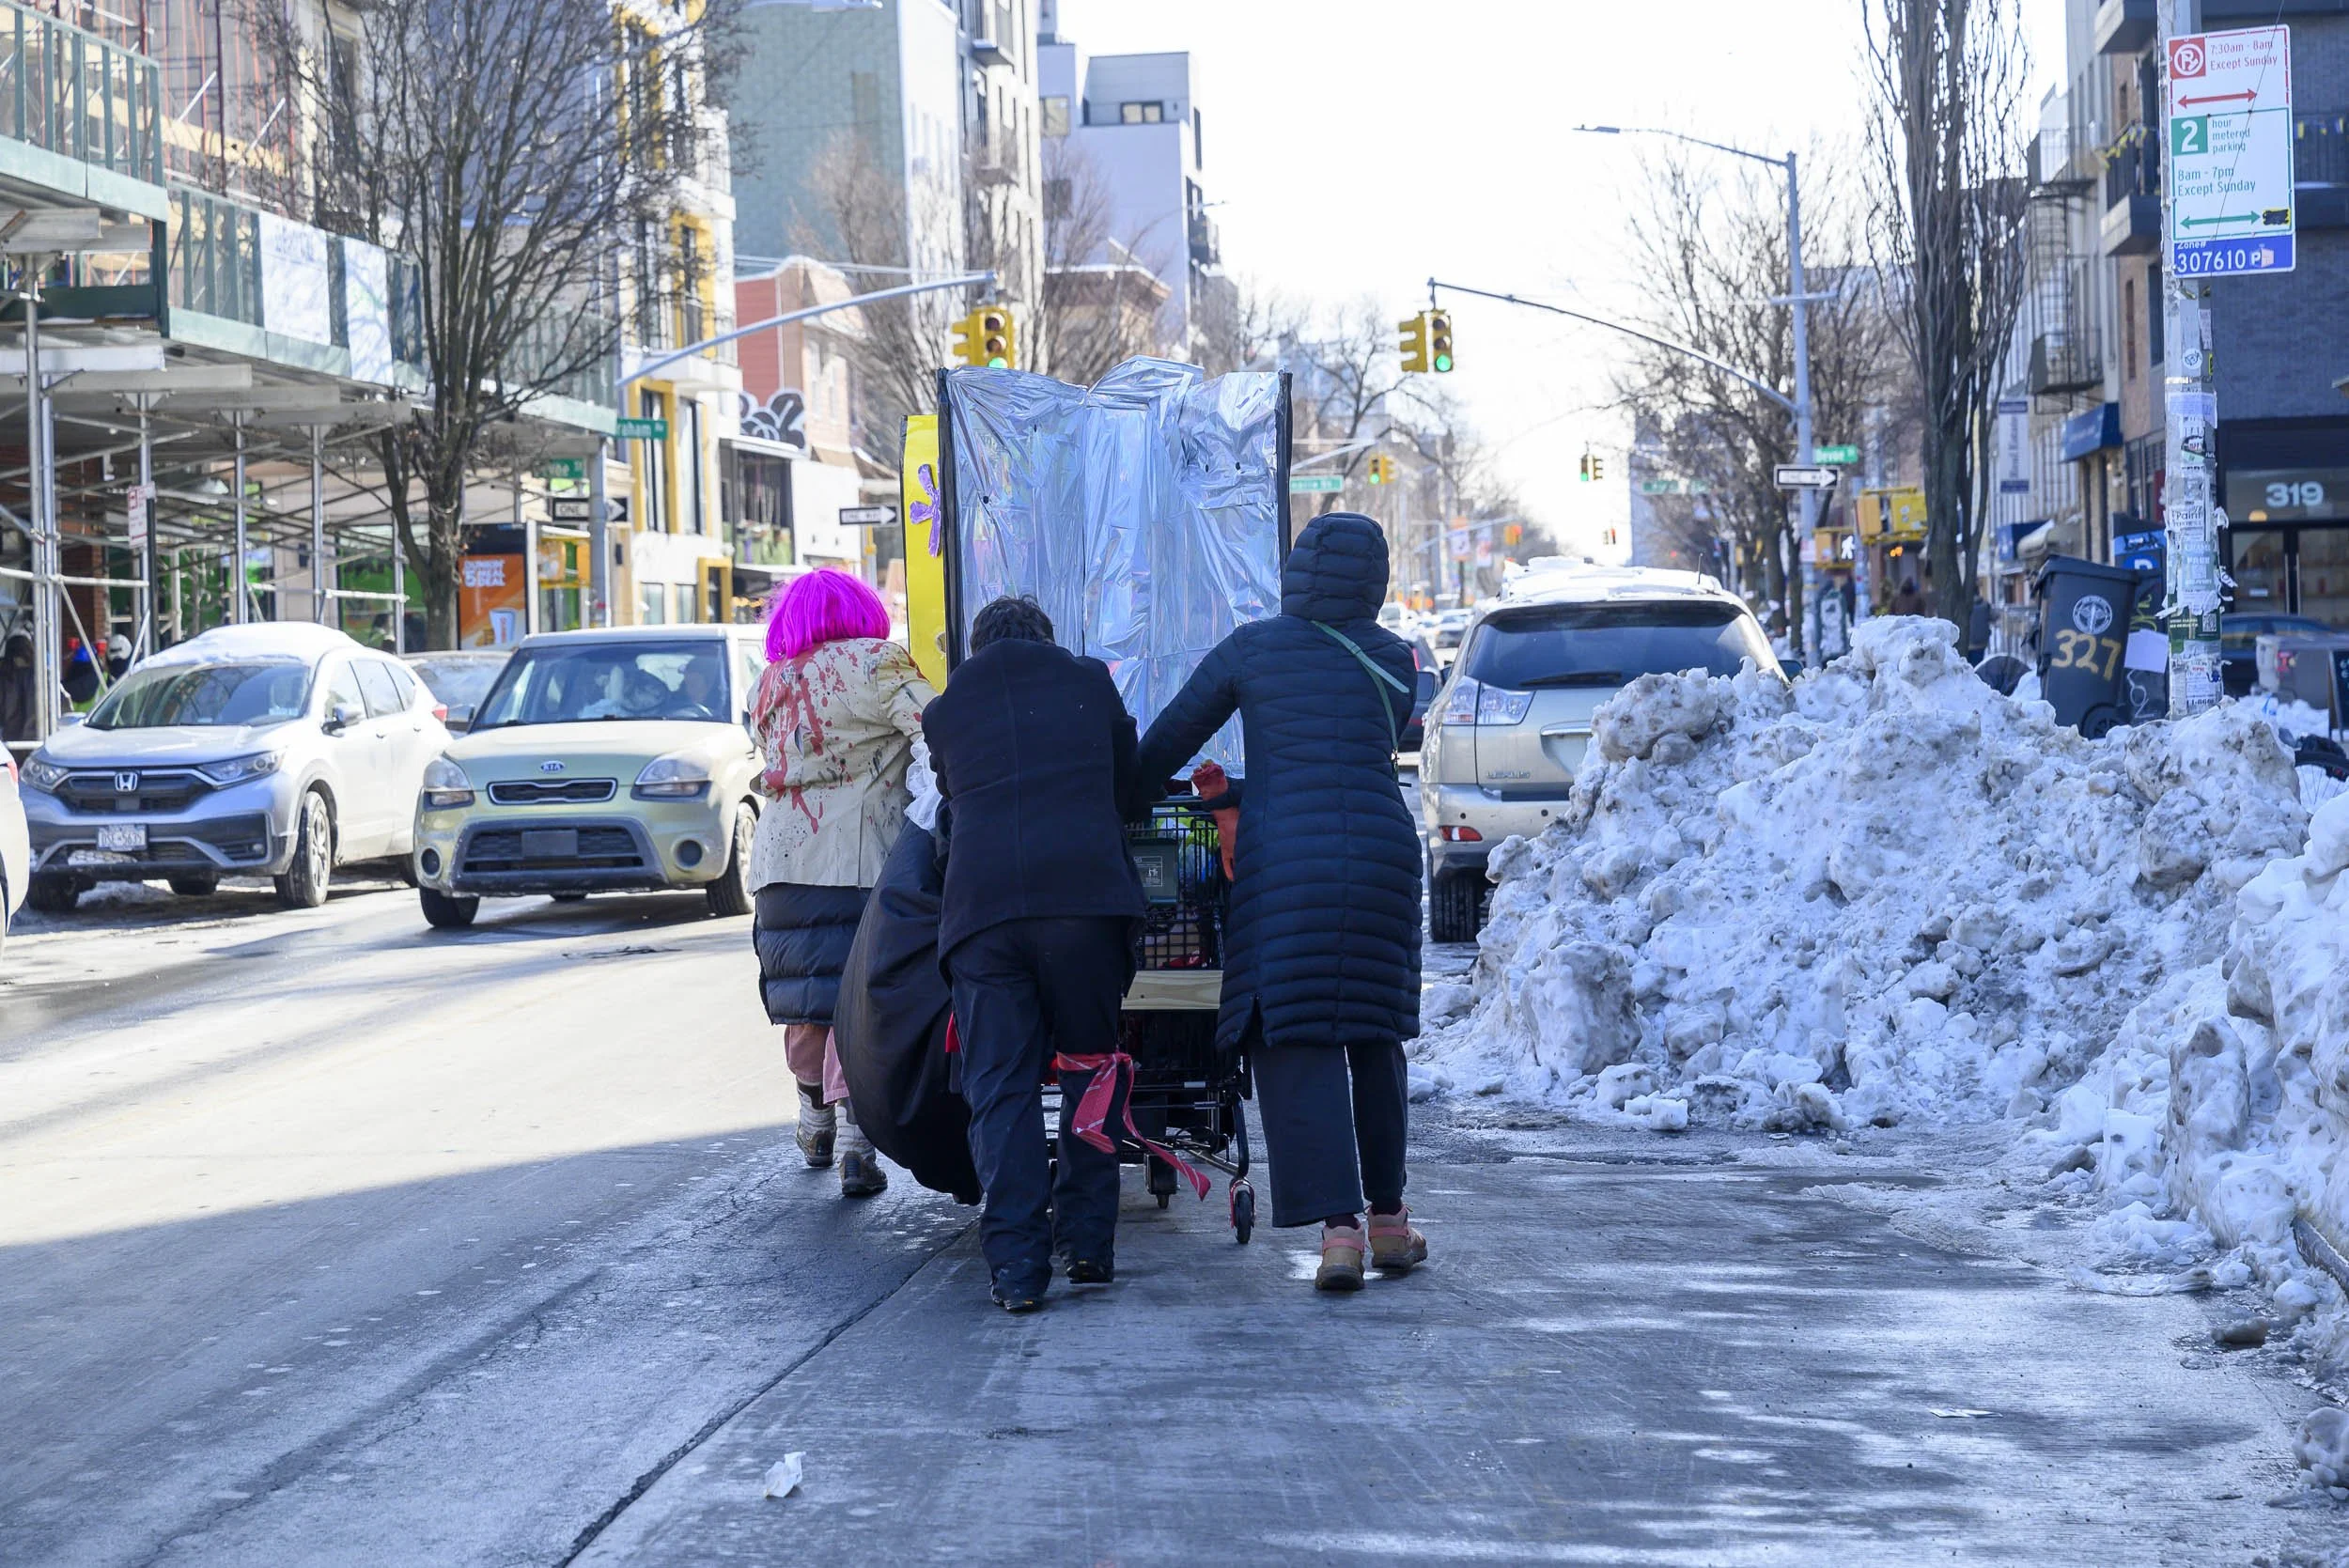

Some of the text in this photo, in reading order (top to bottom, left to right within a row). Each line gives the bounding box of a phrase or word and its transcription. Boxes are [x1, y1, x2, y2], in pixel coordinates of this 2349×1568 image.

[2210, 42, 2244, 55] 7:30am
[2253, 39, 2273, 51] 8am
[2210, 54, 2278, 71] Except Sunday
[2212, 119, 2232, 129] hour
[2181, 119, 2199, 152] 2
[2212, 128, 2250, 141] metered
[2212, 142, 2247, 155] parking
[2178, 169, 2201, 181] 8am
[2213, 166, 2234, 181] 7pm
[2178, 179, 2256, 198] Except Sunday
[2177, 249, 2247, 273] 307610
[615, 422, 652, 437] raham
[2265, 481, 2324, 507] 319
[559, 505, 580, 514] ONE
[2050, 629, 2122, 681] 327
